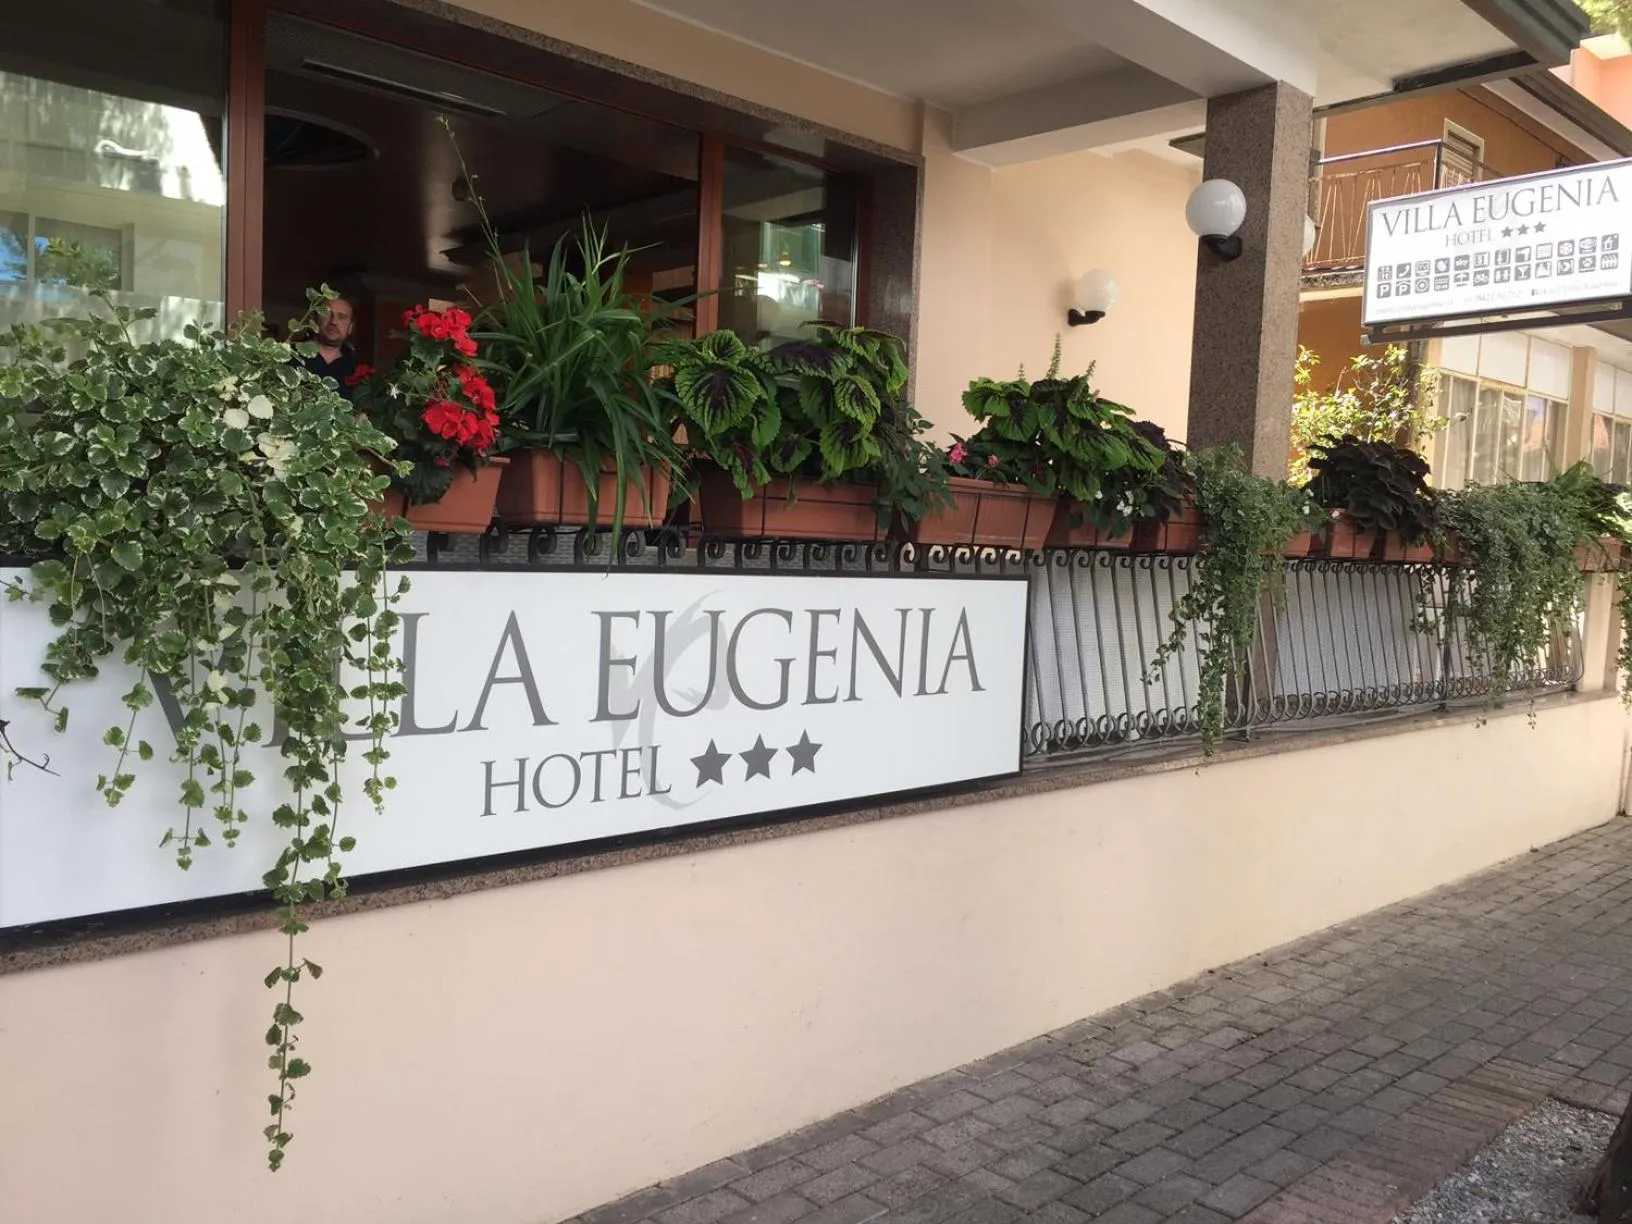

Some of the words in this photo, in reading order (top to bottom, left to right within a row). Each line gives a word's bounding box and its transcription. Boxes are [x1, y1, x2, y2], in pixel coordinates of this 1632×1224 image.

[1382, 201, 1463, 237] VILLA
[1473, 175, 1620, 224] EUGENIA
[1445, 228, 1494, 248] HOTEL
[590, 606, 986, 723] EUGENIA
[479, 744, 672, 818] HOTEL
